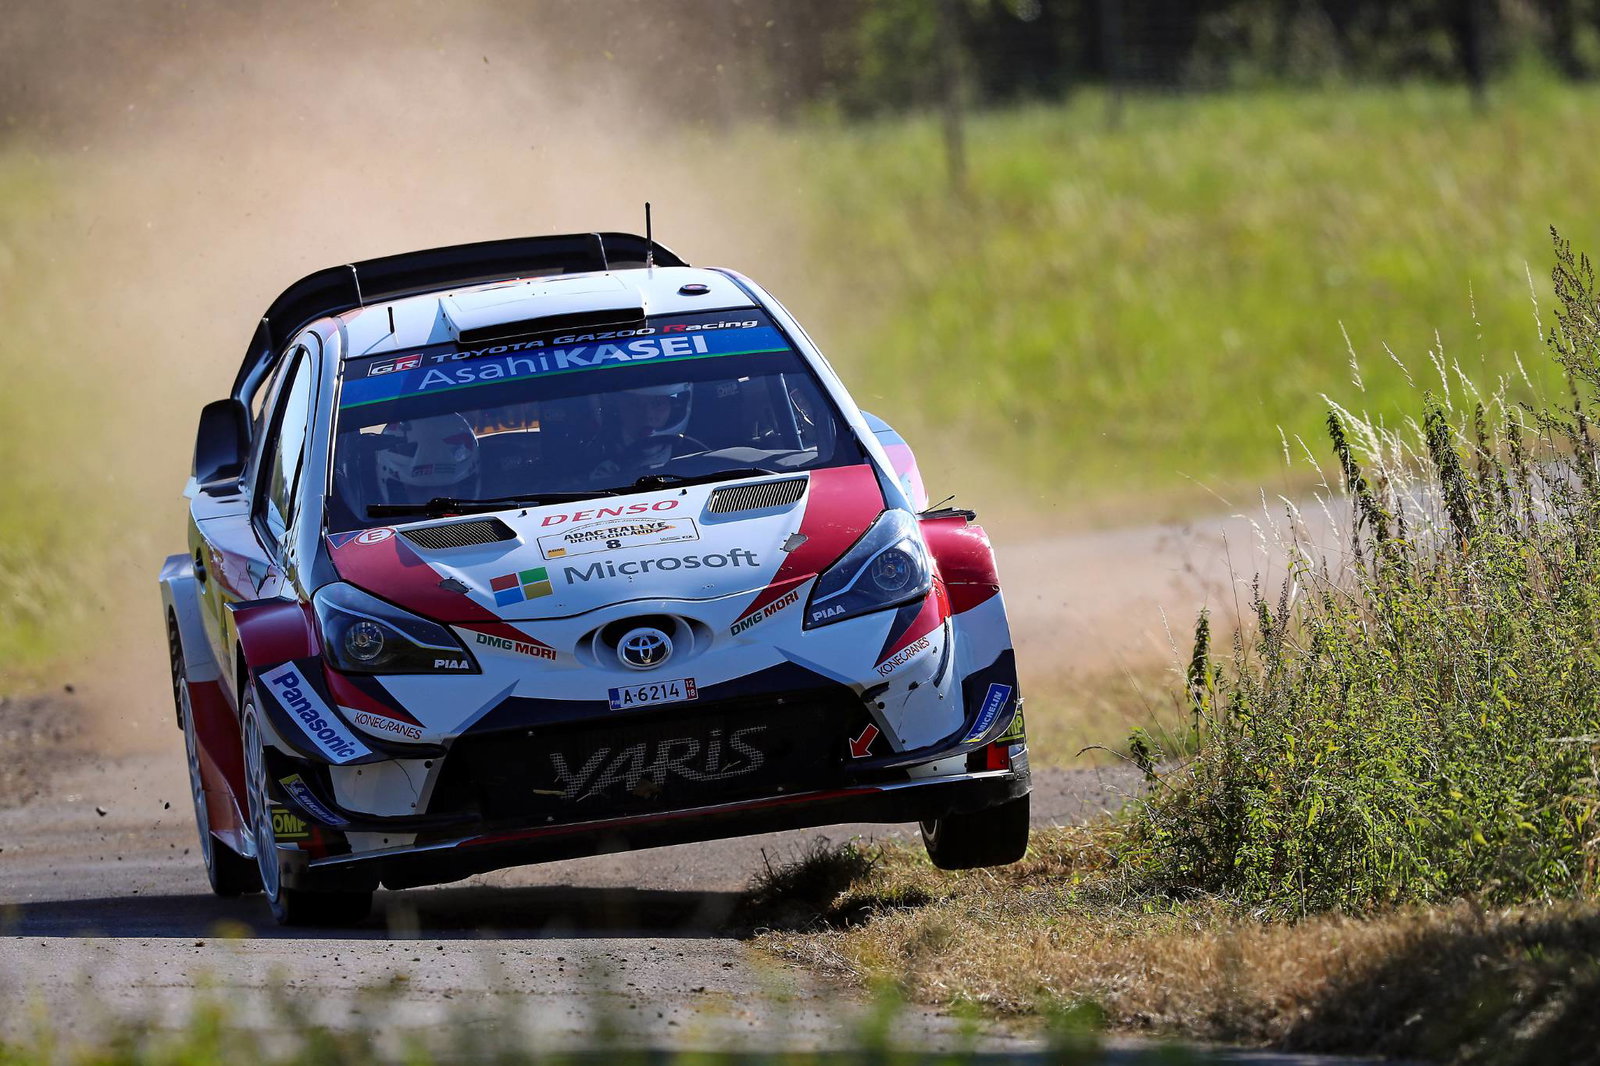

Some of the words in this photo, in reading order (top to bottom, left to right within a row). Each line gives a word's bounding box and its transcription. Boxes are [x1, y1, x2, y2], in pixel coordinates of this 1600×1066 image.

[431, 339, 545, 363] TOYOTA
[553, 326, 656, 345] GAZOO
[663, 319, 759, 333] Racing
[371, 359, 419, 375] GR
[540, 499, 680, 527] DENSO
[367, 530, 383, 541] E
[564, 529, 605, 541] ADAC
[608, 521, 666, 534] RALLYE
[570, 529, 654, 544] DEUTSCHLAND
[605, 539, 622, 549] 8
[563, 547, 760, 585] Microsoft
[731, 612, 763, 636] DMG
[763, 590, 800, 617] MORI
[812, 604, 846, 622] PIAA
[476, 633, 513, 650] DMG
[515, 642, 557, 660] MORI
[876, 636, 930, 678] KONECRANES
[433, 659, 470, 669] PIAA
[623, 683, 680, 705] A-6214
[686, 680, 695, 688] 12
[687, 689, 696, 697] 18
[271, 670, 357, 758] Panasonic
[977, 690, 1003, 731] MICHELIN
[354, 711, 423, 740] KONECRANES
